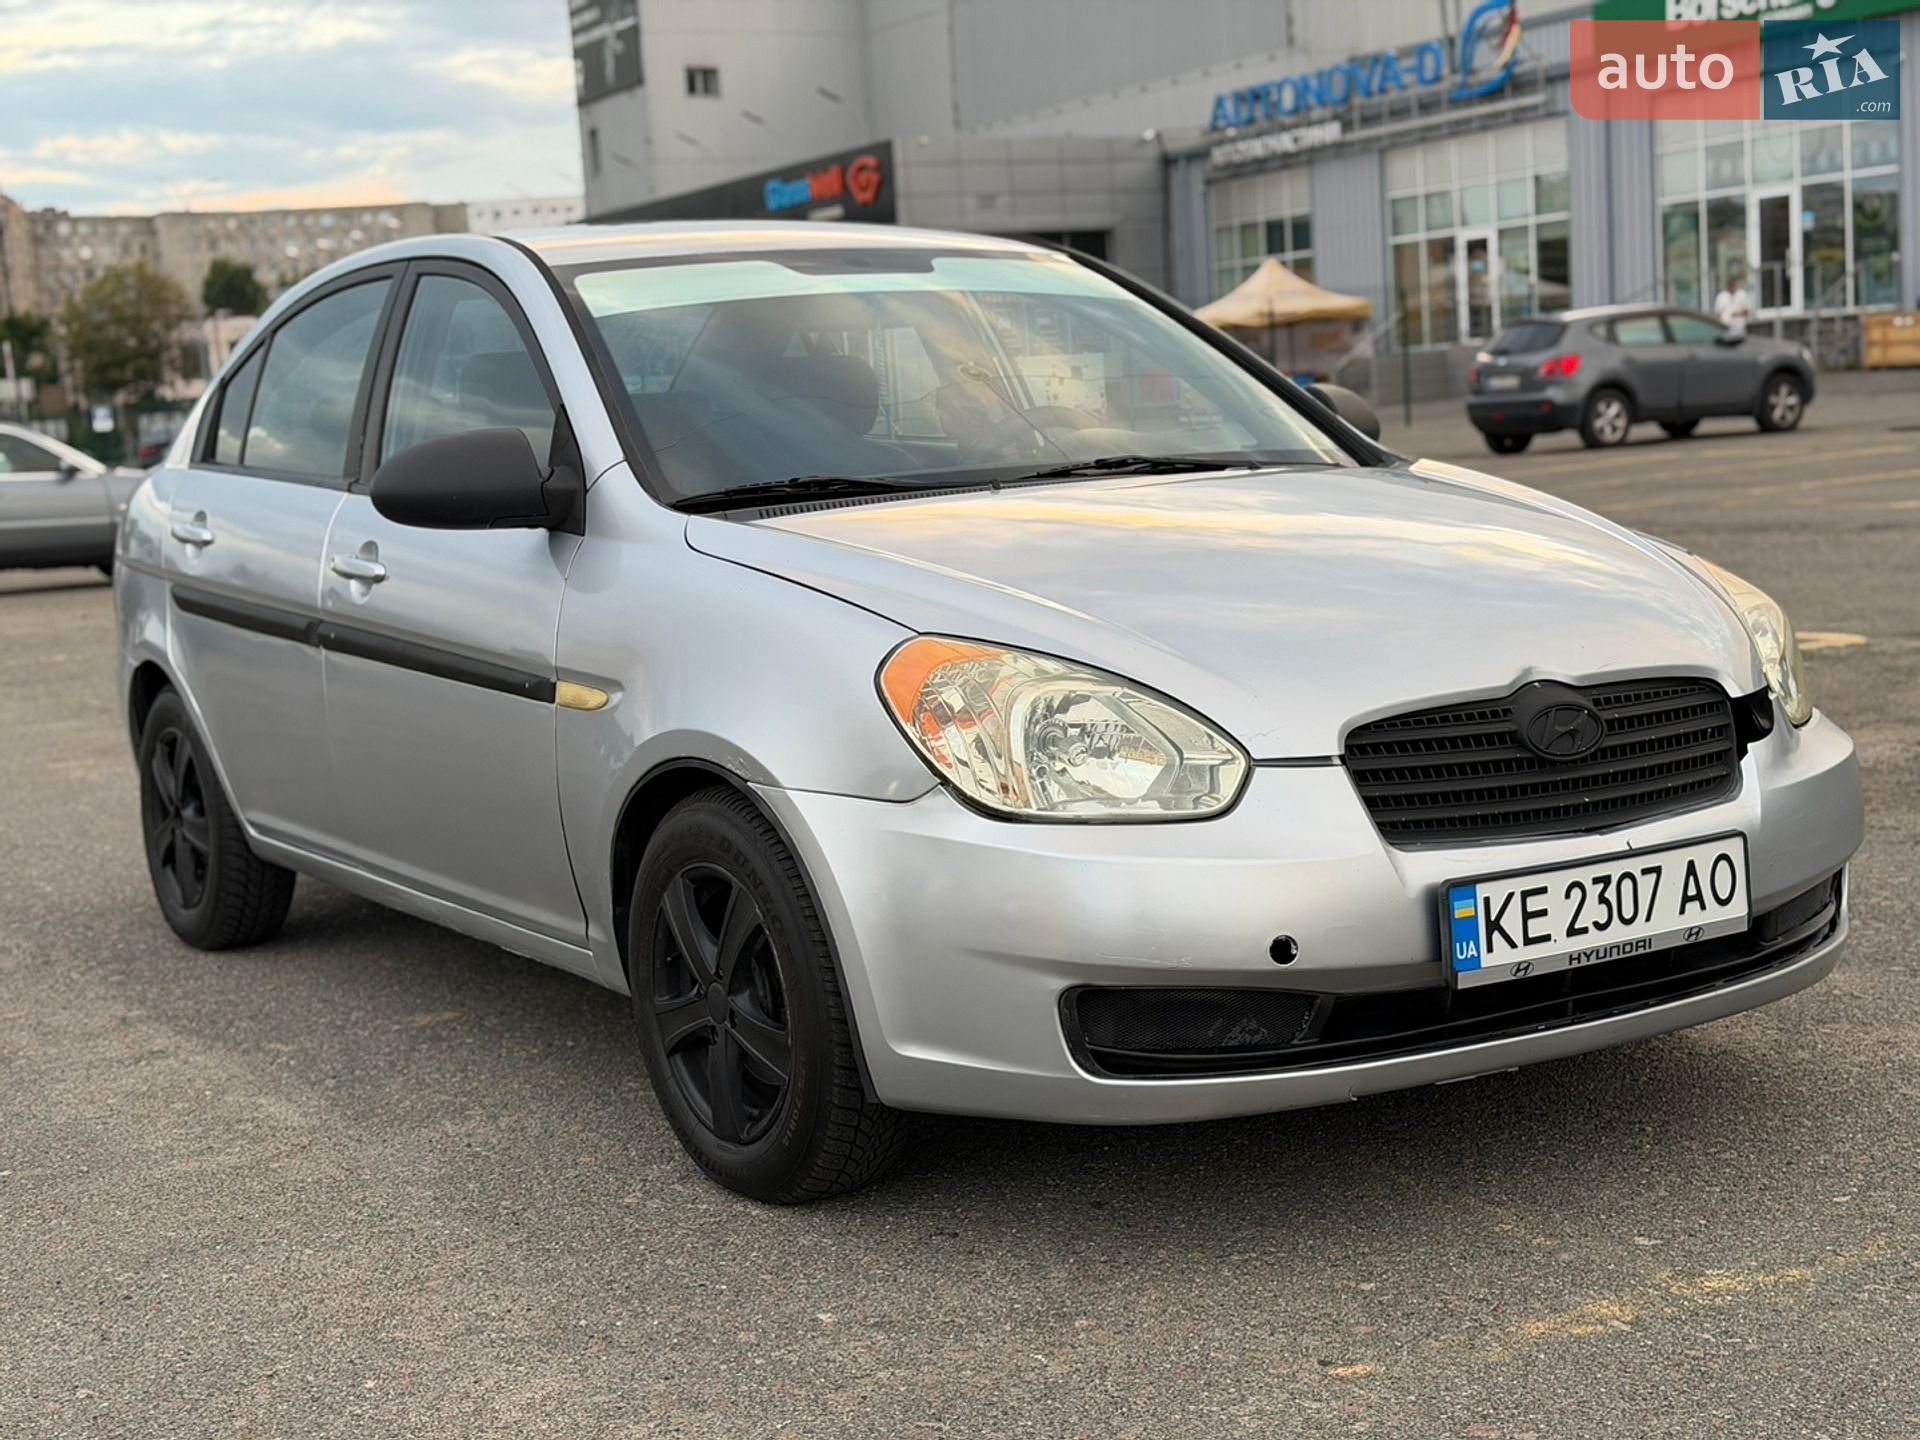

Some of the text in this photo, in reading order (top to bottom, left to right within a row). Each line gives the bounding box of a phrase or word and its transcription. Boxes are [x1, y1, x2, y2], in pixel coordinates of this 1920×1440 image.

[1210, 40, 1444, 131] AUTONOVA-D
[1483, 852, 1737, 954] KE 2307 AO
[1456, 939, 1479, 960] UA
[1568, 937, 1653, 967] HYUNDAI
